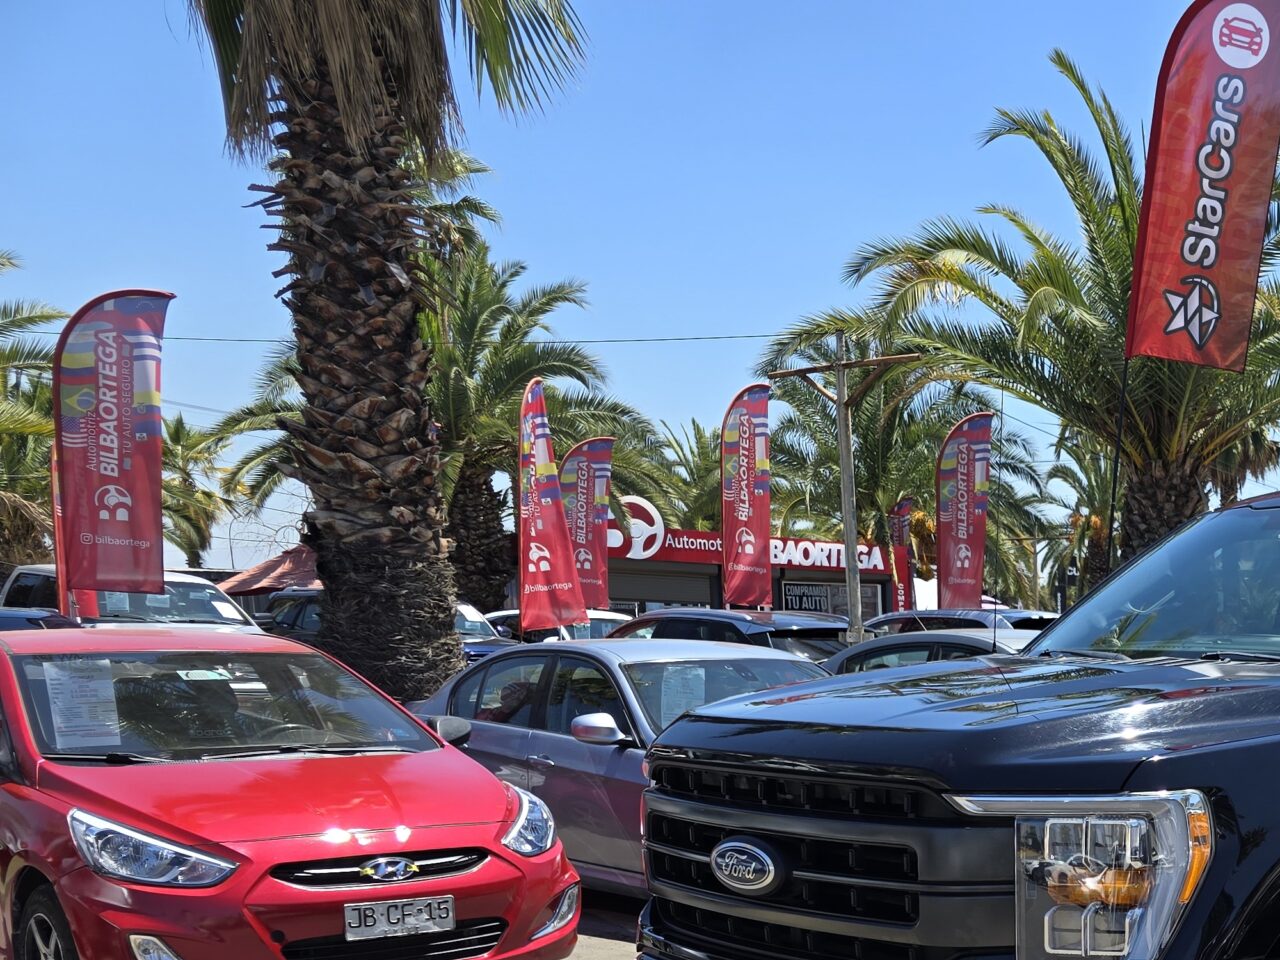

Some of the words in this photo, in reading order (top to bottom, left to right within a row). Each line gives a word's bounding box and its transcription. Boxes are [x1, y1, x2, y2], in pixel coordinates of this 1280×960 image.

[1182, 74, 1245, 268] StarCars
[122, 359, 132, 404] SEGURO
[99, 331, 118, 477] BILBAORTEGA
[122, 407, 132, 437] AUTO
[86, 411, 97, 471] Automotriz
[122, 440, 132, 454] TU
[576, 461, 588, 544] BILBAORTEGA
[957, 443, 969, 539] BILBAORTEGA
[95, 535, 150, 549] bilbaortega
[665, 533, 722, 551] Automot
[786, 585, 827, 597] COMPRAMOS
[786, 597, 799, 609] TU
[801, 597, 827, 610] AUTO
[722, 851, 756, 879] Ford
